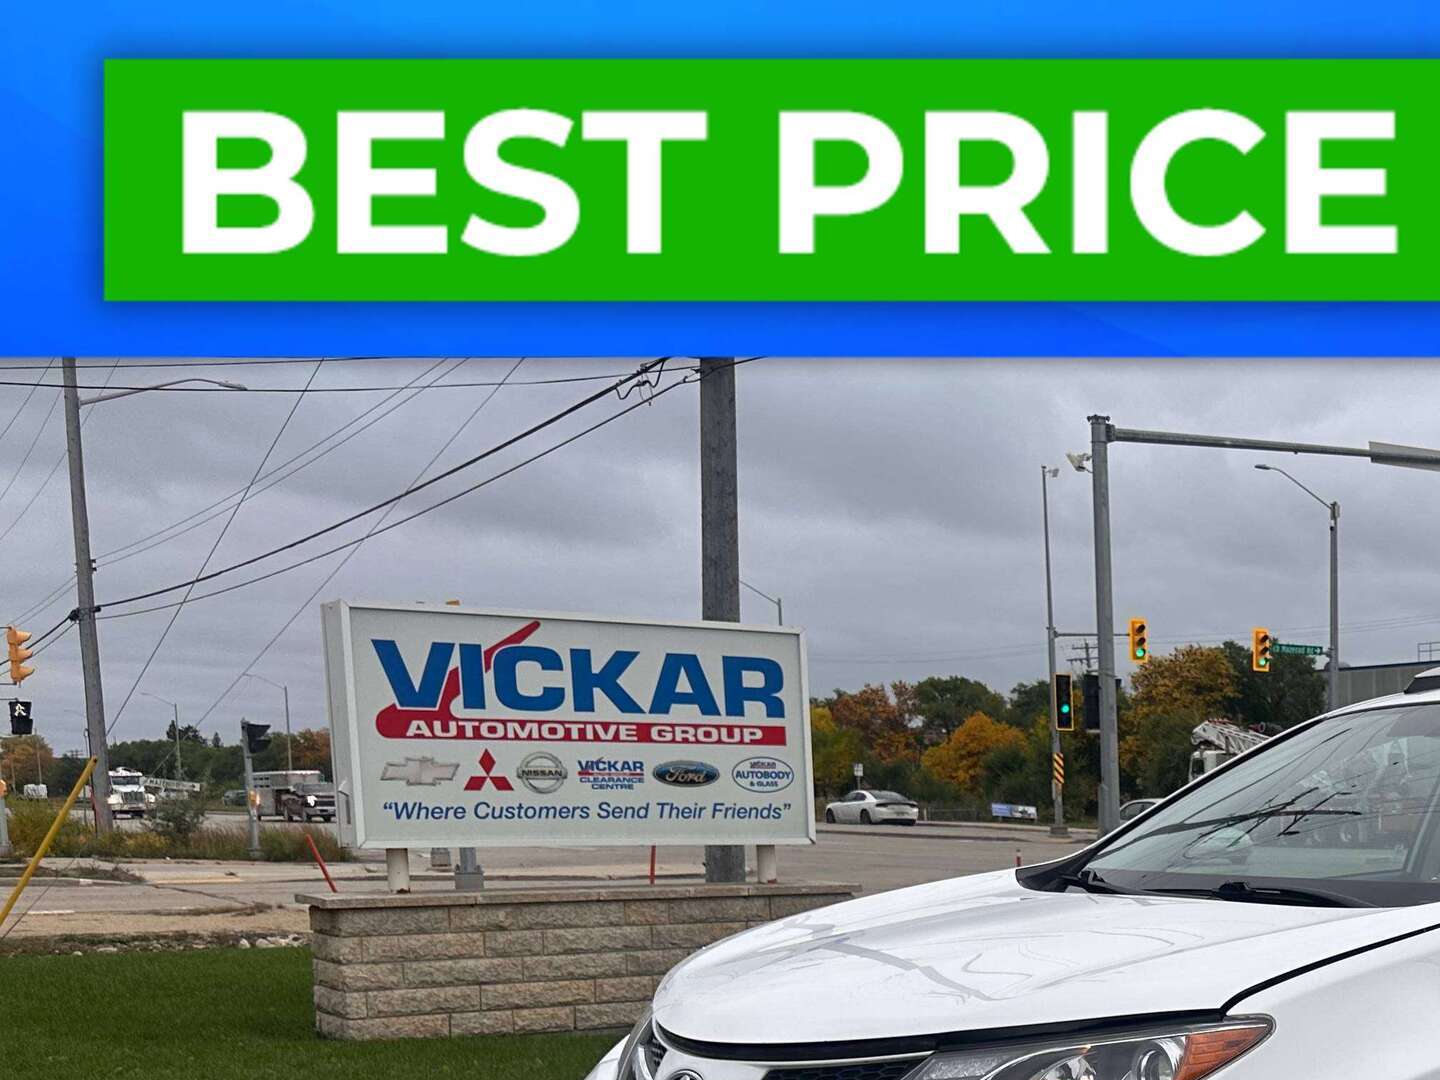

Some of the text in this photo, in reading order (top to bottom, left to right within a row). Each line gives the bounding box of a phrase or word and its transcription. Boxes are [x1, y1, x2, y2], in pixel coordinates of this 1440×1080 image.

[370, 638, 786, 719] VICKAR
[405, 718, 764, 744] AUTOMOTIVE GROUP
[577, 759, 645, 772] VICKAR
[521, 769, 563, 778] NISSAN
[579, 776, 645, 784] CLEARANCE
[664, 766, 706, 784] Ford
[735, 770, 791, 780] AUTOBODY
[473, 801, 590, 820] Customers
[597, 801, 650, 820] Send
[656, 802, 706, 820] Their
